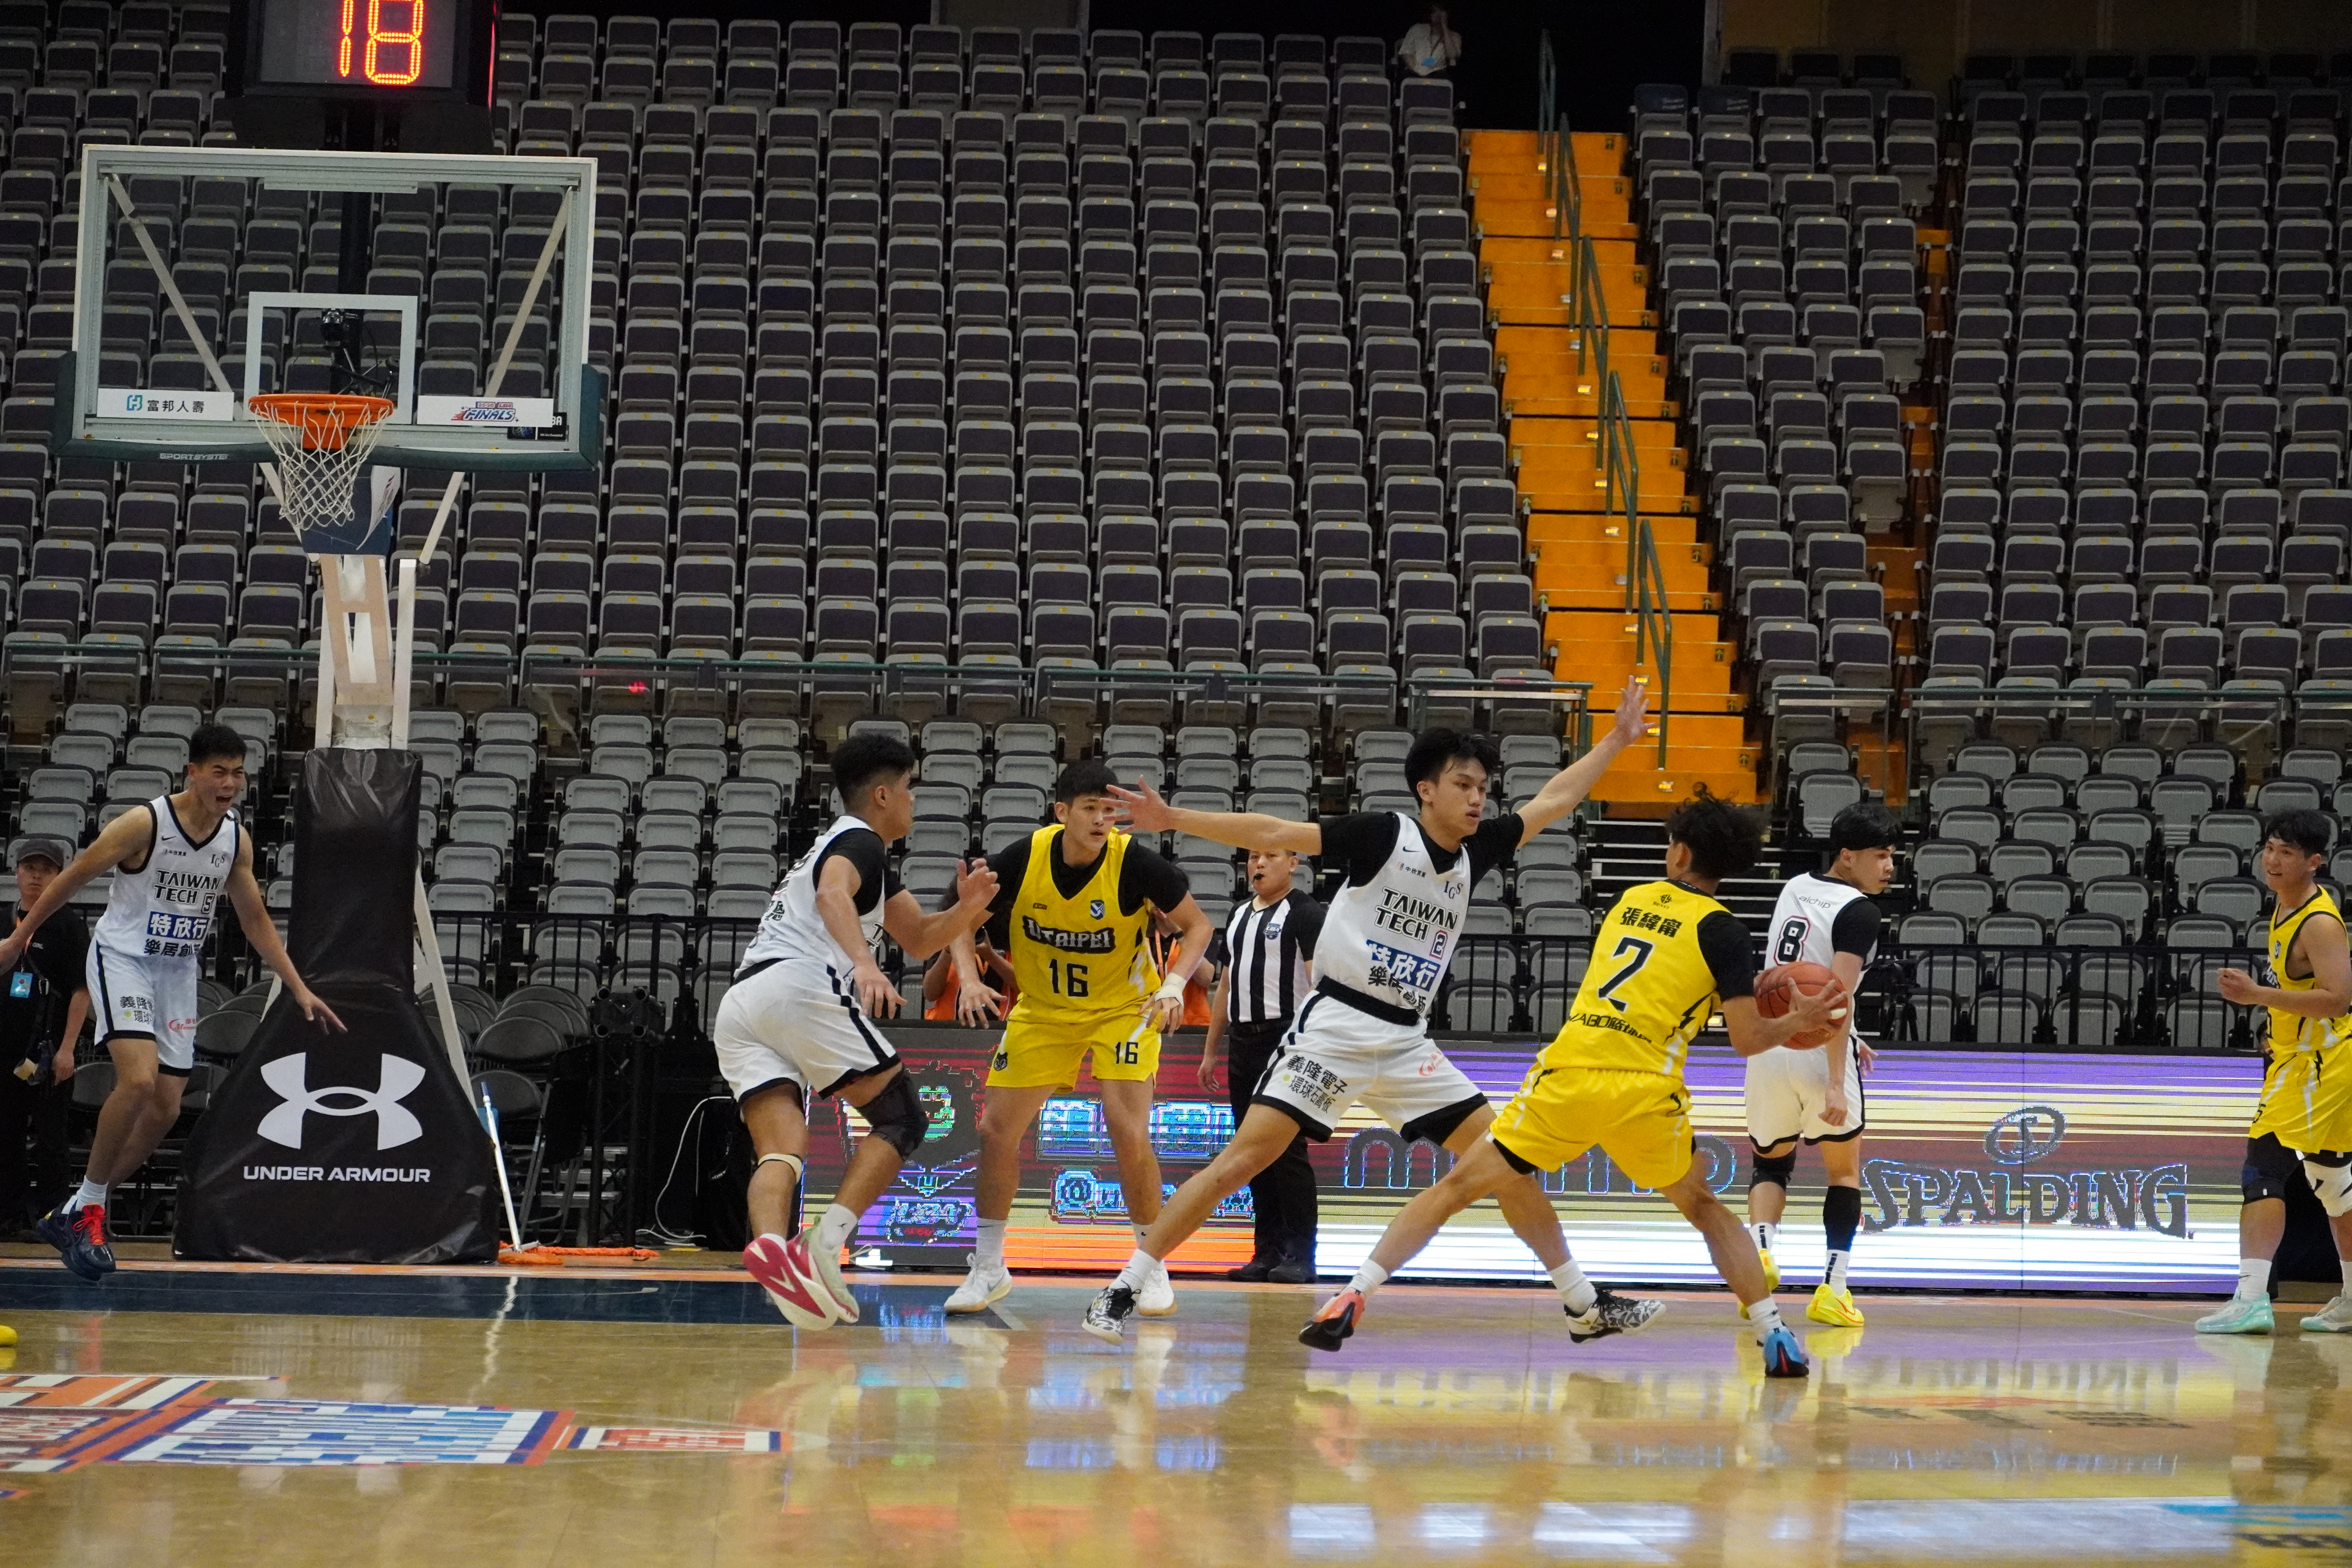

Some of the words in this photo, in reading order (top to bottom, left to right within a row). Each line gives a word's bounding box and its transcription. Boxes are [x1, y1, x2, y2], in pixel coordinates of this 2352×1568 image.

[340, 0, 424, 84] 18
[147, 400, 204, 413] 富邦人壽
[463, 409, 515, 421] FINALS
[552, 416, 562, 426] BA
[211, 854, 226, 867] IGS
[157, 869, 223, 891] TAIWAN
[1444, 881, 1464, 899] IGS
[153, 884, 198, 905] TECH
[201, 892, 215, 914] 5
[1799, 895, 1831, 909] alchip
[1382, 886, 1459, 932] TAIWAN
[150, 914, 208, 939] 特欣行
[1027, 918, 1111, 948] UTAIPEI
[1375, 905, 1430, 943] TECH
[1430, 930, 1448, 960] 2
[1773, 915, 1811, 963] 8
[1048, 958, 1089, 997] 16
[1598, 936, 1654, 1013] 2
[1114, 1042, 1138, 1064] 16
[1287, 1054, 1348, 1095] 義隆電子
[1288, 1076, 1336, 1113] 環球石膏板
[243, 1166, 323, 1180] UNDER
[327, 1167, 431, 1182] ARMOUR
[1860, 1160, 2188, 1239] SPALDING
